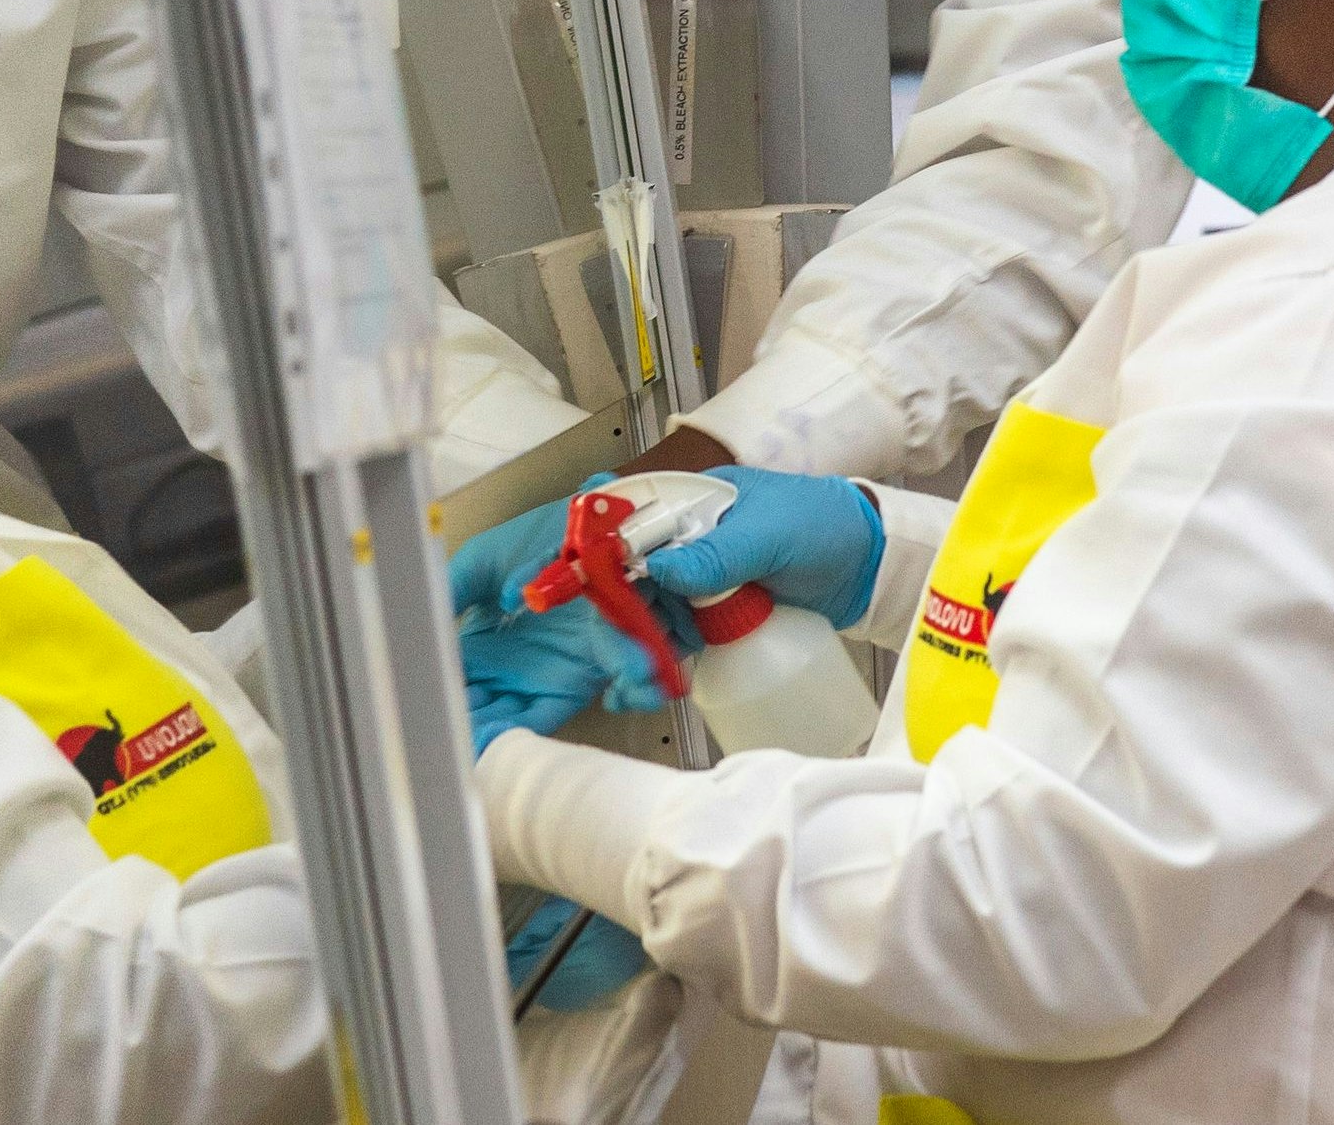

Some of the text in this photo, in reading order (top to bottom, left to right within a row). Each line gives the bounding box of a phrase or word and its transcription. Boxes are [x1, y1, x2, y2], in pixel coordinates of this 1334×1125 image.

[677, 8, 690, 82] EXTRACTION
[675, 86, 688, 132] BLEACH
[674, 133, 686, 161] 0.5%
